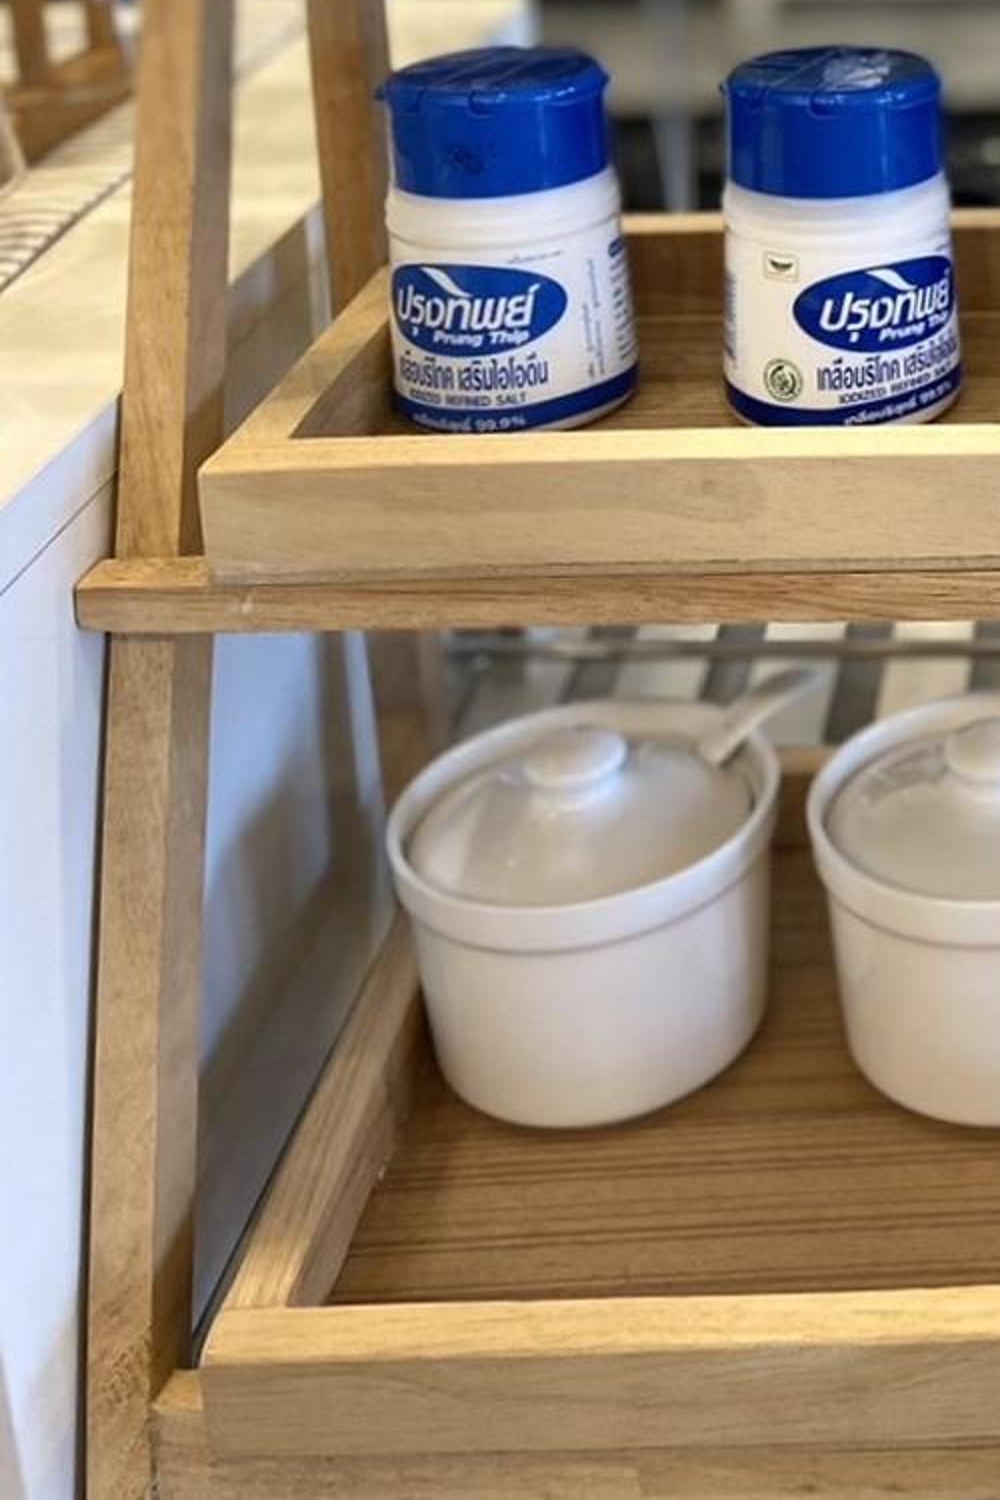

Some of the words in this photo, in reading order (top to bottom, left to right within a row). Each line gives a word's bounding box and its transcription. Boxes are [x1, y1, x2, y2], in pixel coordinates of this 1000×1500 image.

[396, 282, 542, 337] ปรุงทิพย์
[432, 329, 484, 348] Prung
[488, 330, 530, 348] Thip
[879, 323, 925, 343] Prung
[816, 355, 901, 391] เกลือบริโภค
[495, 391, 527, 406] SALT
